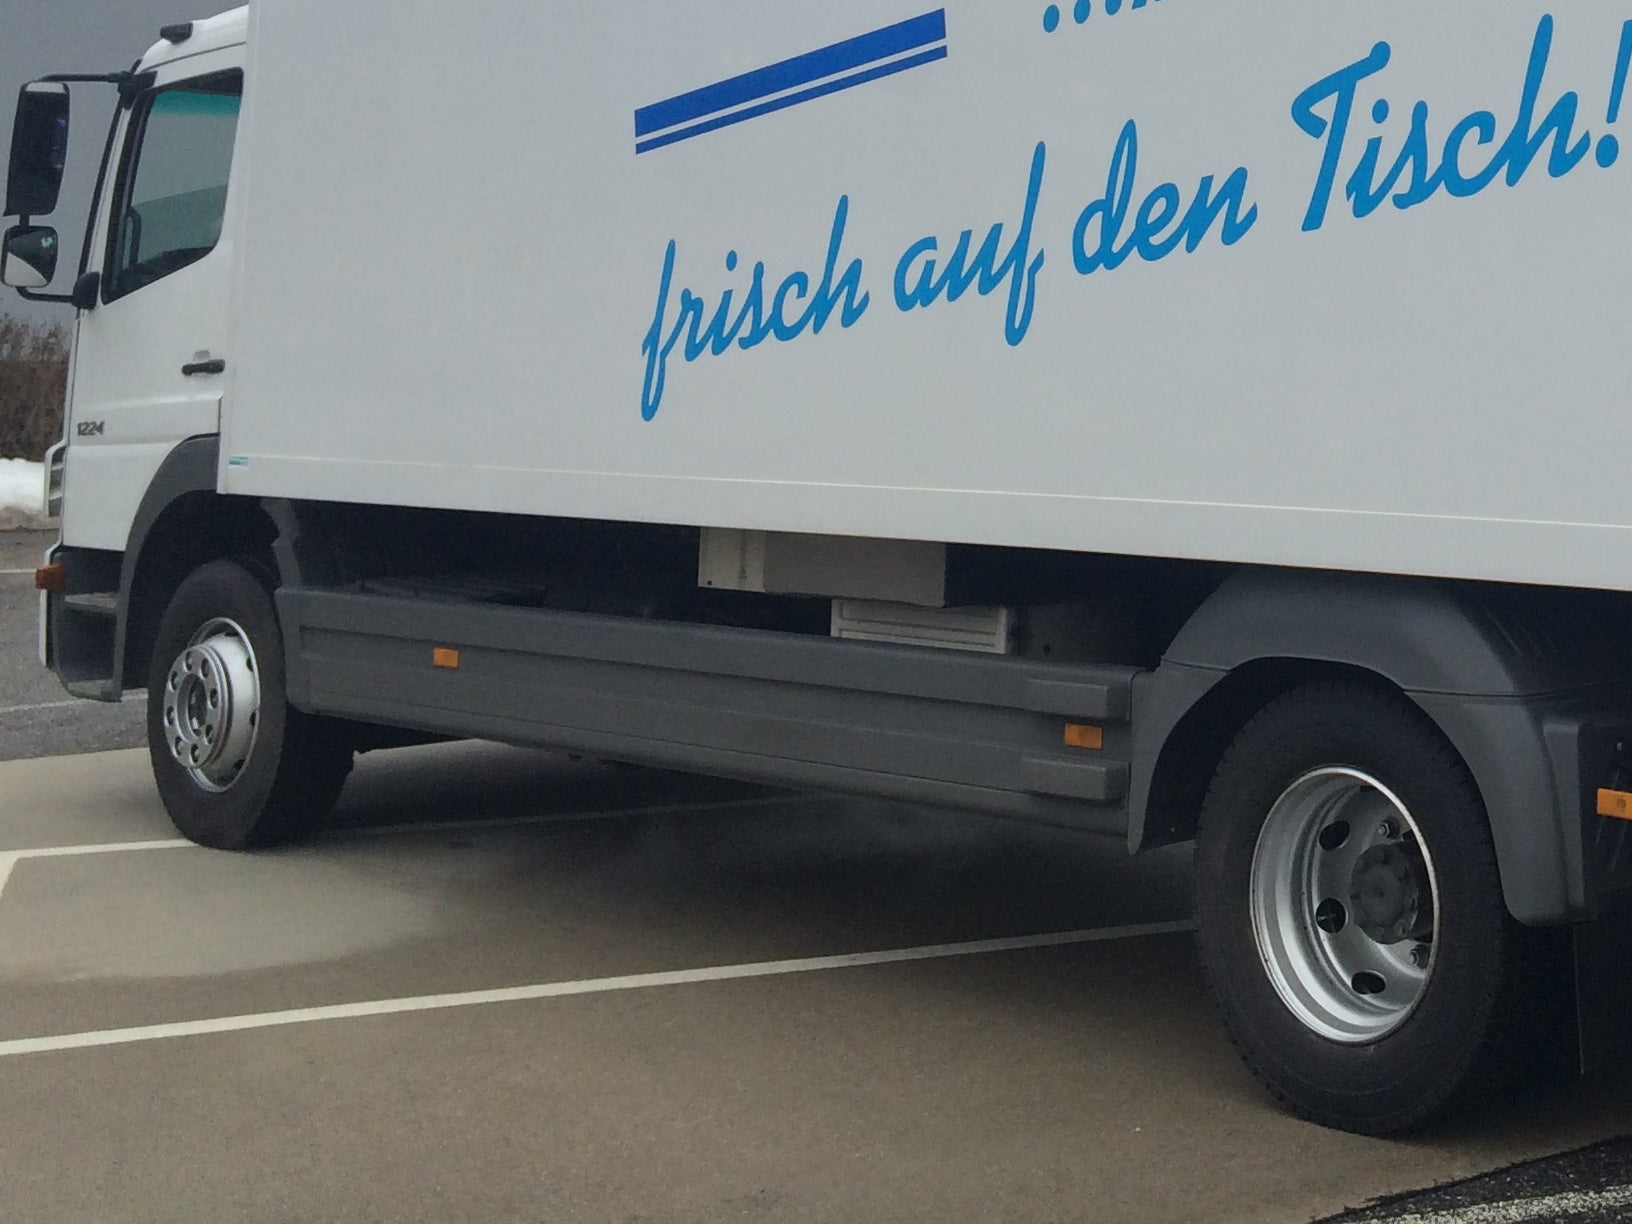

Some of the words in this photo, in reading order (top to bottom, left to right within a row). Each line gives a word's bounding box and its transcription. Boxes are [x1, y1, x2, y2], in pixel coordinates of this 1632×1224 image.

[641, 195, 869, 422] frisch
[893, 142, 1046, 347] auf
[1071, 120, 1258, 276] den
[77, 421, 105, 436] 1224
